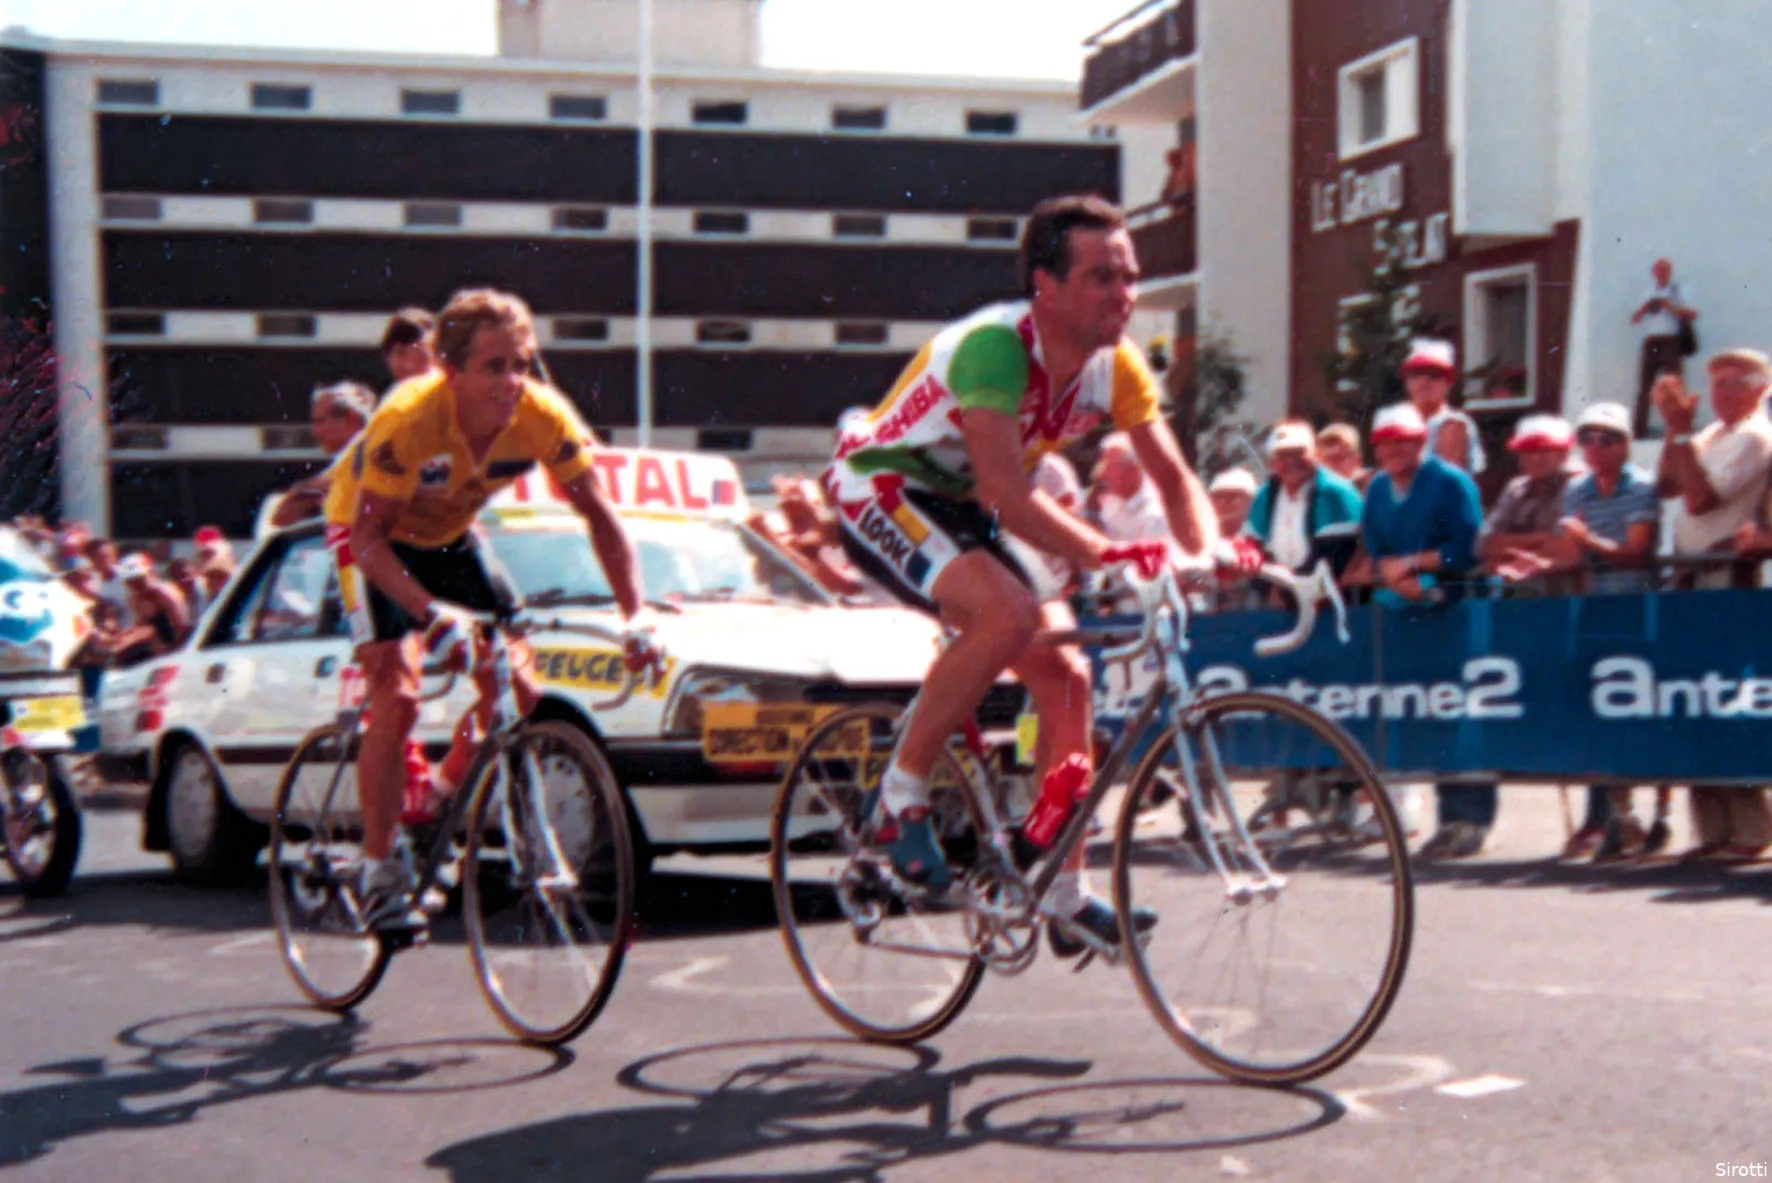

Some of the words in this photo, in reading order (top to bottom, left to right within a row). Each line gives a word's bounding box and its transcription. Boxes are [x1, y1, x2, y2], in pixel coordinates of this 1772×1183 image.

[513, 453, 709, 509] TAL
[858, 505, 911, 569] LOOK
[534, 650, 660, 690] PEUGE
